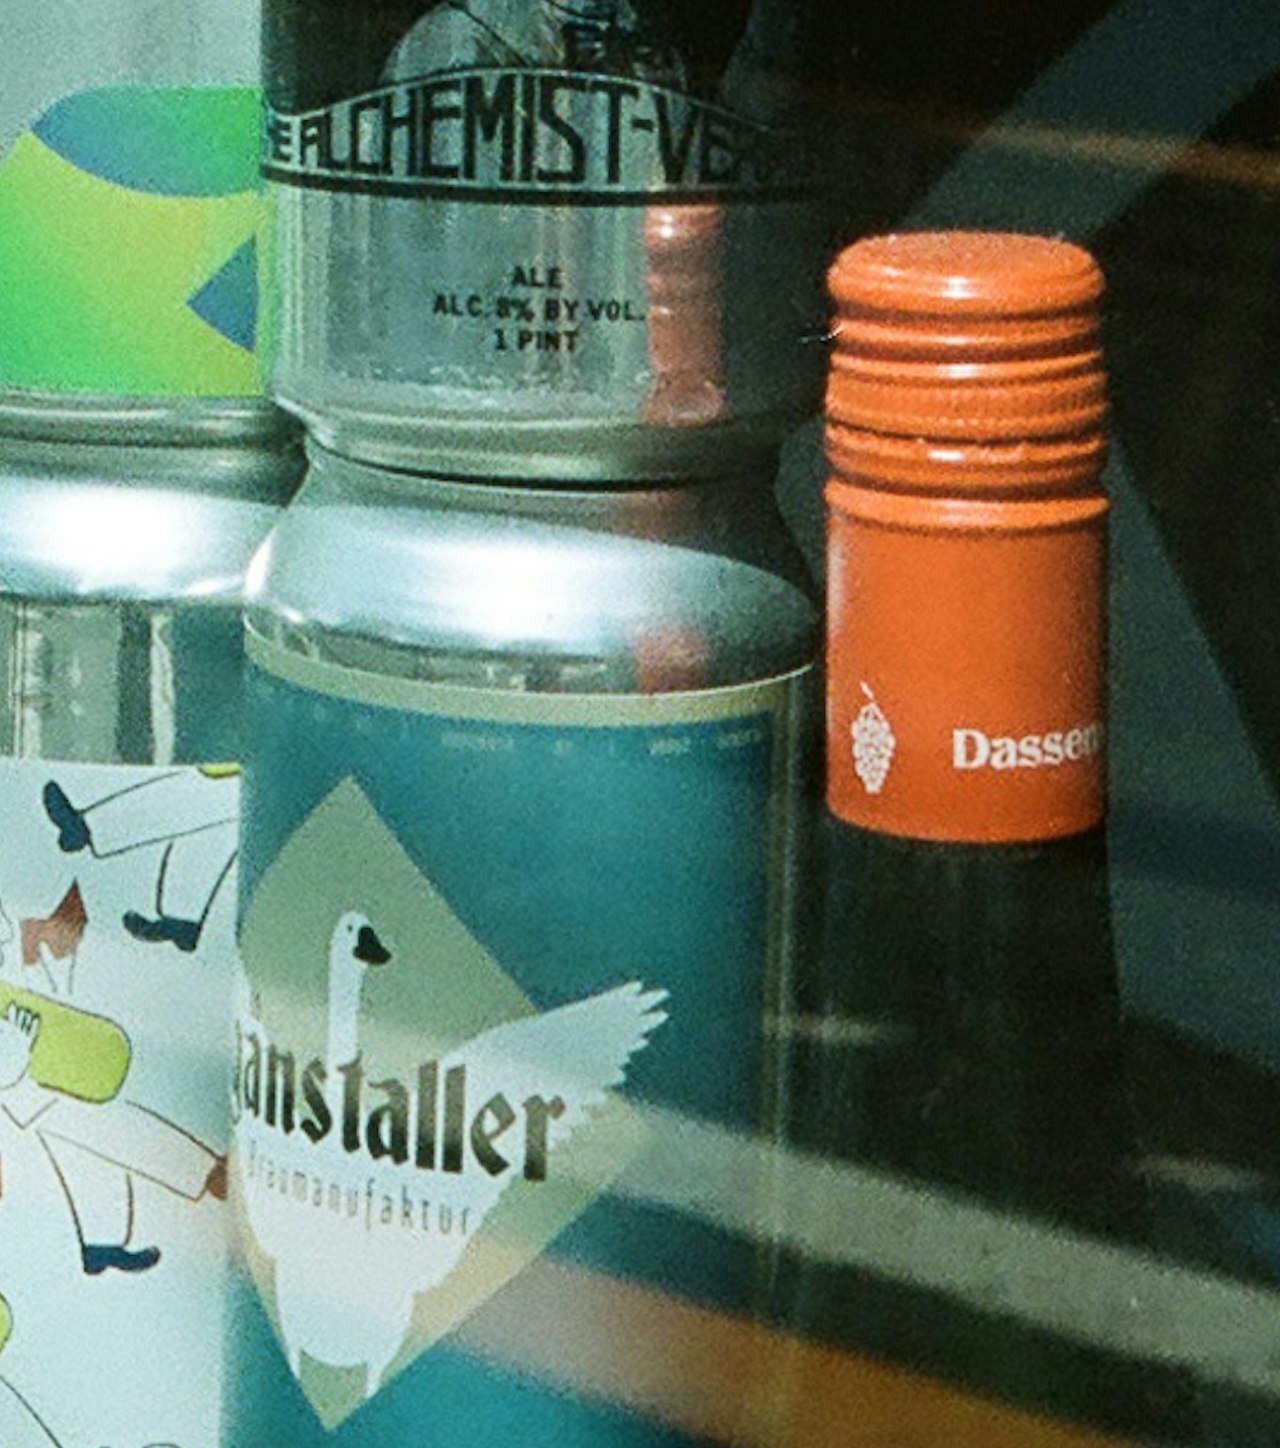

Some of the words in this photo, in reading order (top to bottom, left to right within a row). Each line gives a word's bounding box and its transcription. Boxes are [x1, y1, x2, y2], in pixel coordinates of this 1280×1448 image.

[511, 265, 563, 289] ALE
[495, 295, 536, 322] 8%
[544, 298, 579, 321] BY
[586, 299, 647, 322] VOL.
[493, 327, 508, 351] 1
[517, 329, 579, 353] PINT
